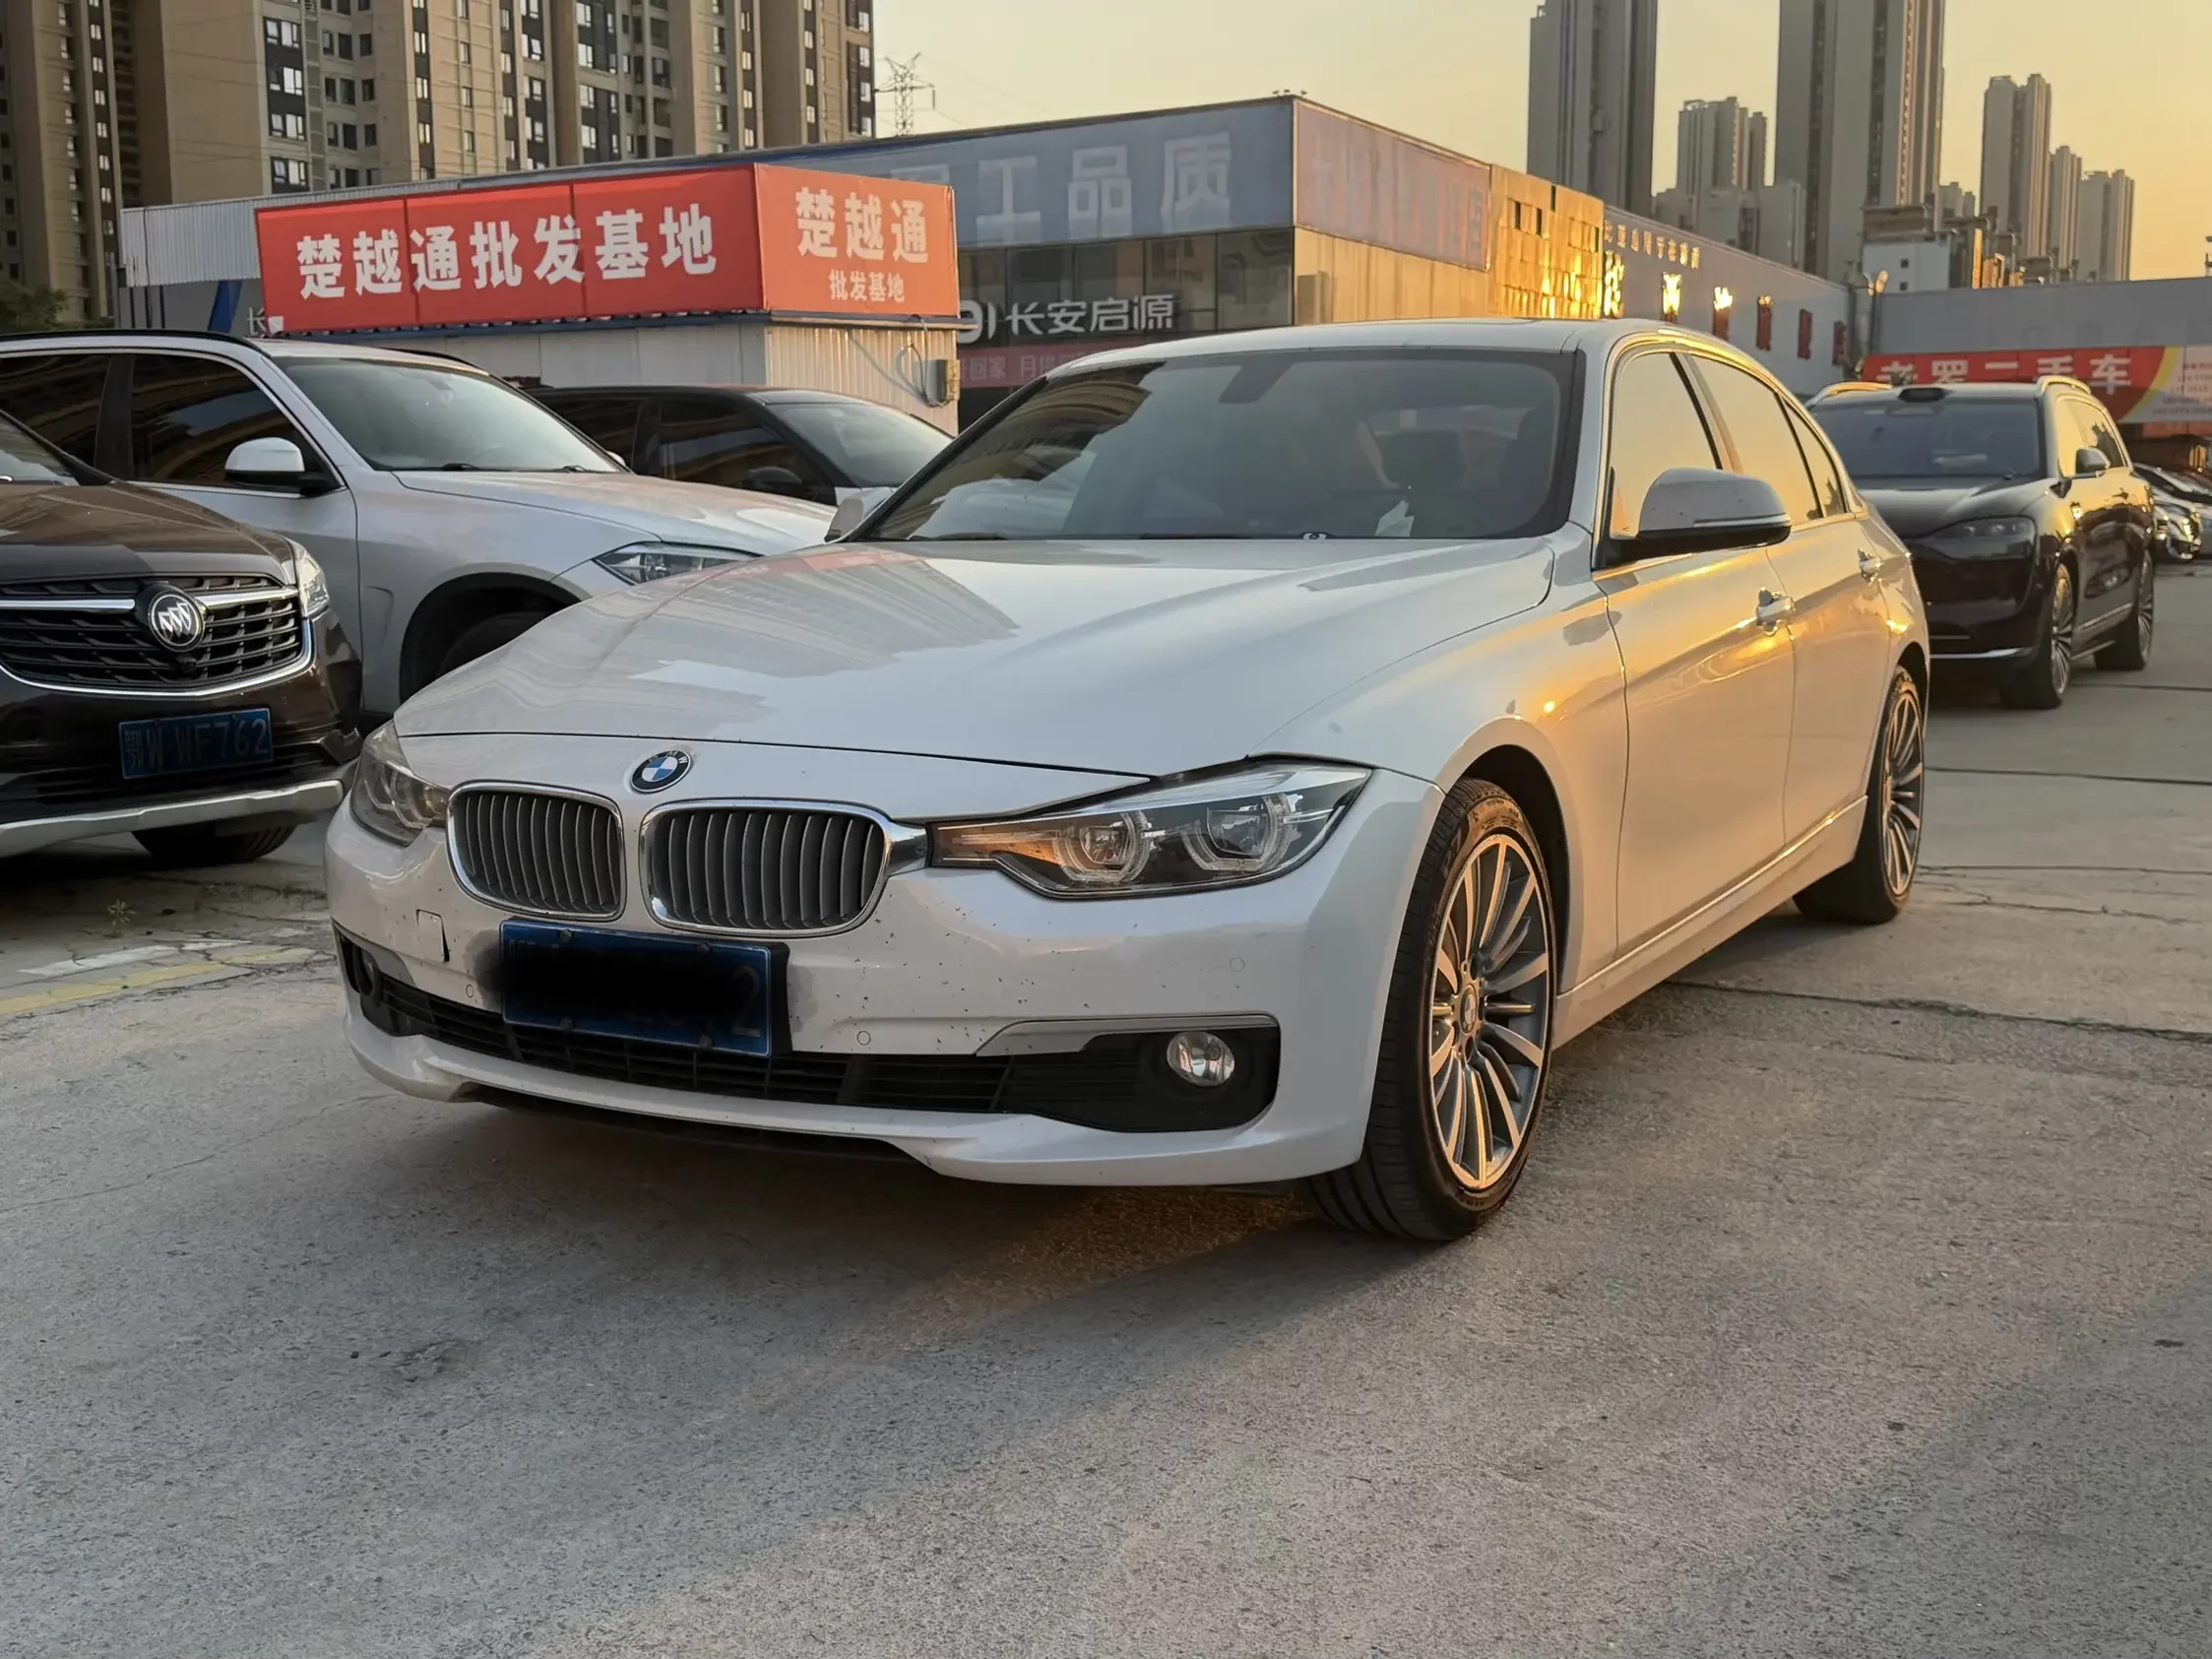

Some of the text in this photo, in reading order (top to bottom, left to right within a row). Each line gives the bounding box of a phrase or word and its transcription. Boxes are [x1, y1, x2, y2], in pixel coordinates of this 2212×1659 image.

[891, 132, 1232, 236] 工品质
[296, 203, 718, 299] 楚越通批发基地
[795, 186, 928, 263] 楚越通
[828, 269, 906, 303] 批发基地
[1005, 294, 1173, 336] 长安启源
